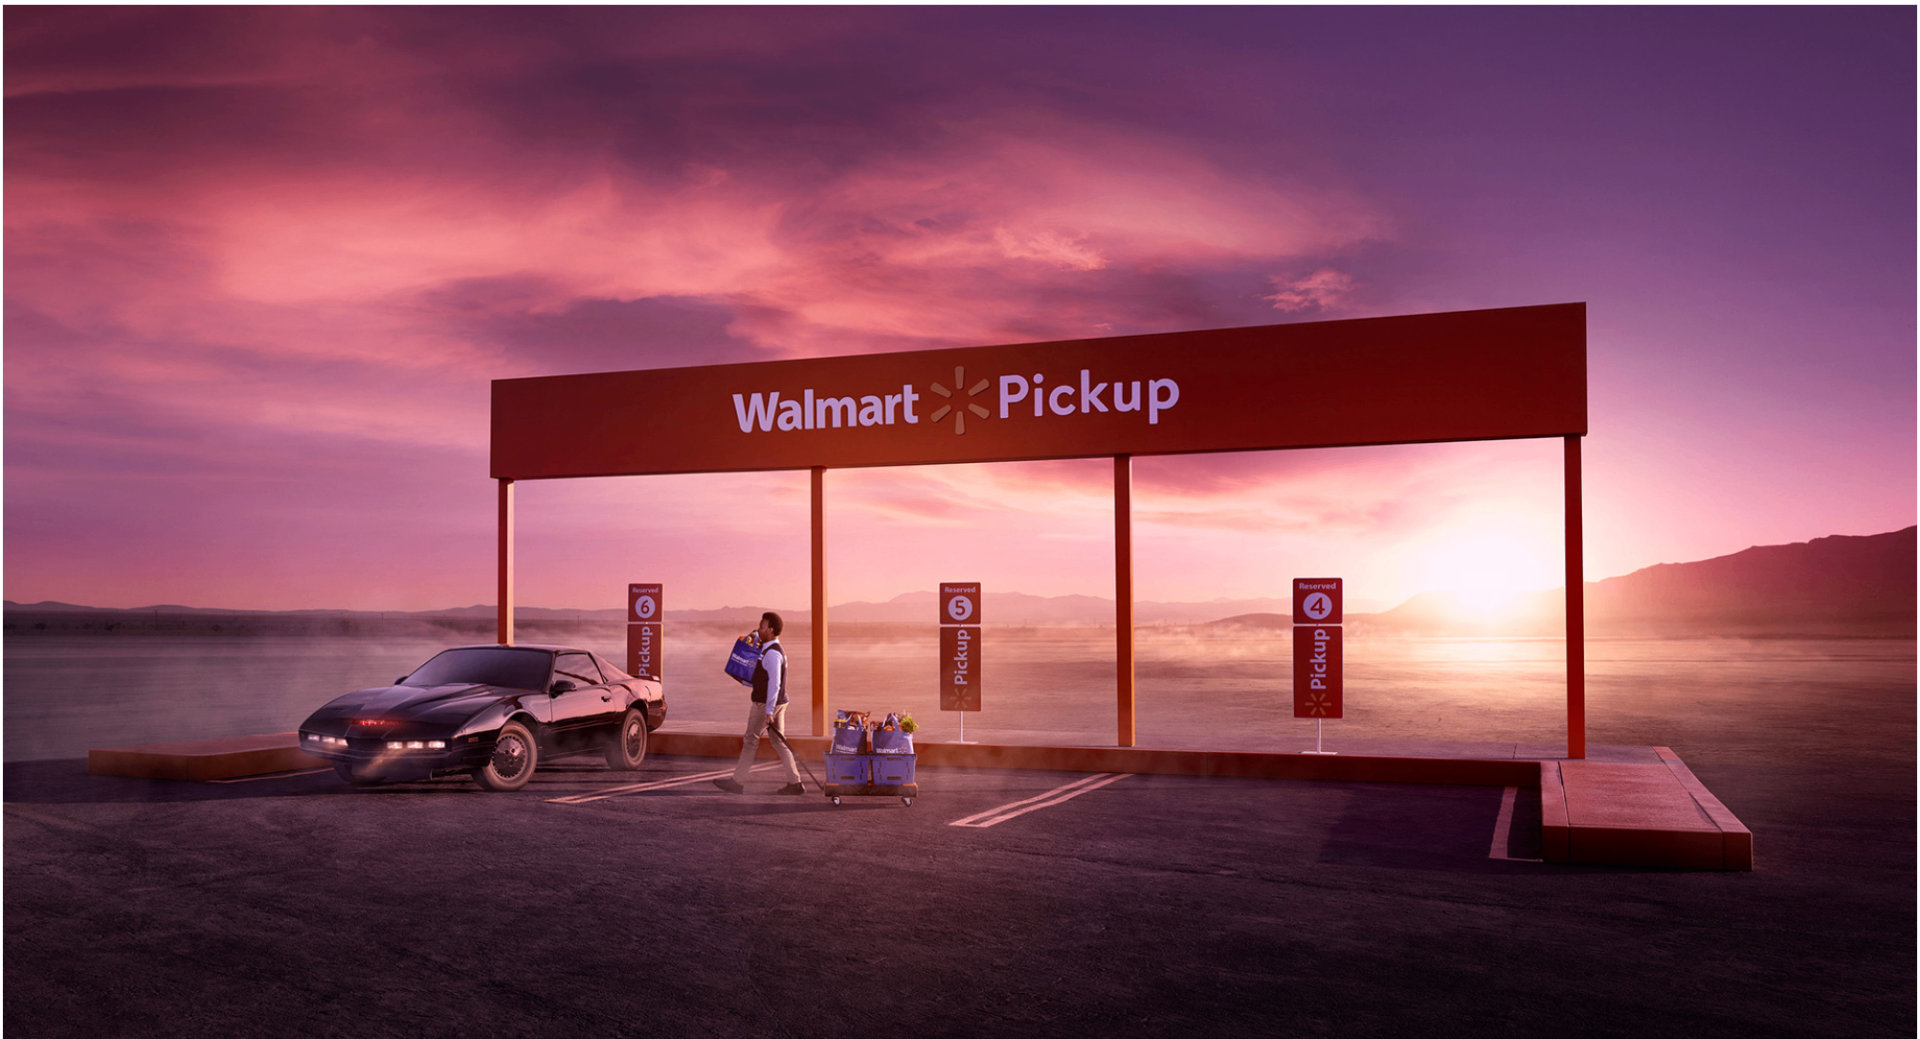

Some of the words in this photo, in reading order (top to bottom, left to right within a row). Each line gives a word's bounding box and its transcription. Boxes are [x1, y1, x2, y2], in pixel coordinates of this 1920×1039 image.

[733, 384, 919, 433] Walmart
[1000, 369, 1180, 425] Pickup
[1299, 582, 1336, 590] Reserved
[641, 600, 649, 614] 6
[955, 600, 966, 616] 5
[1310, 597, 1325, 615] 4
[638, 626, 653, 676] Pickup
[953, 629, 971, 685] Pickup
[1309, 629, 1330, 689] Pickup
[835, 744, 858, 752] Walmart
